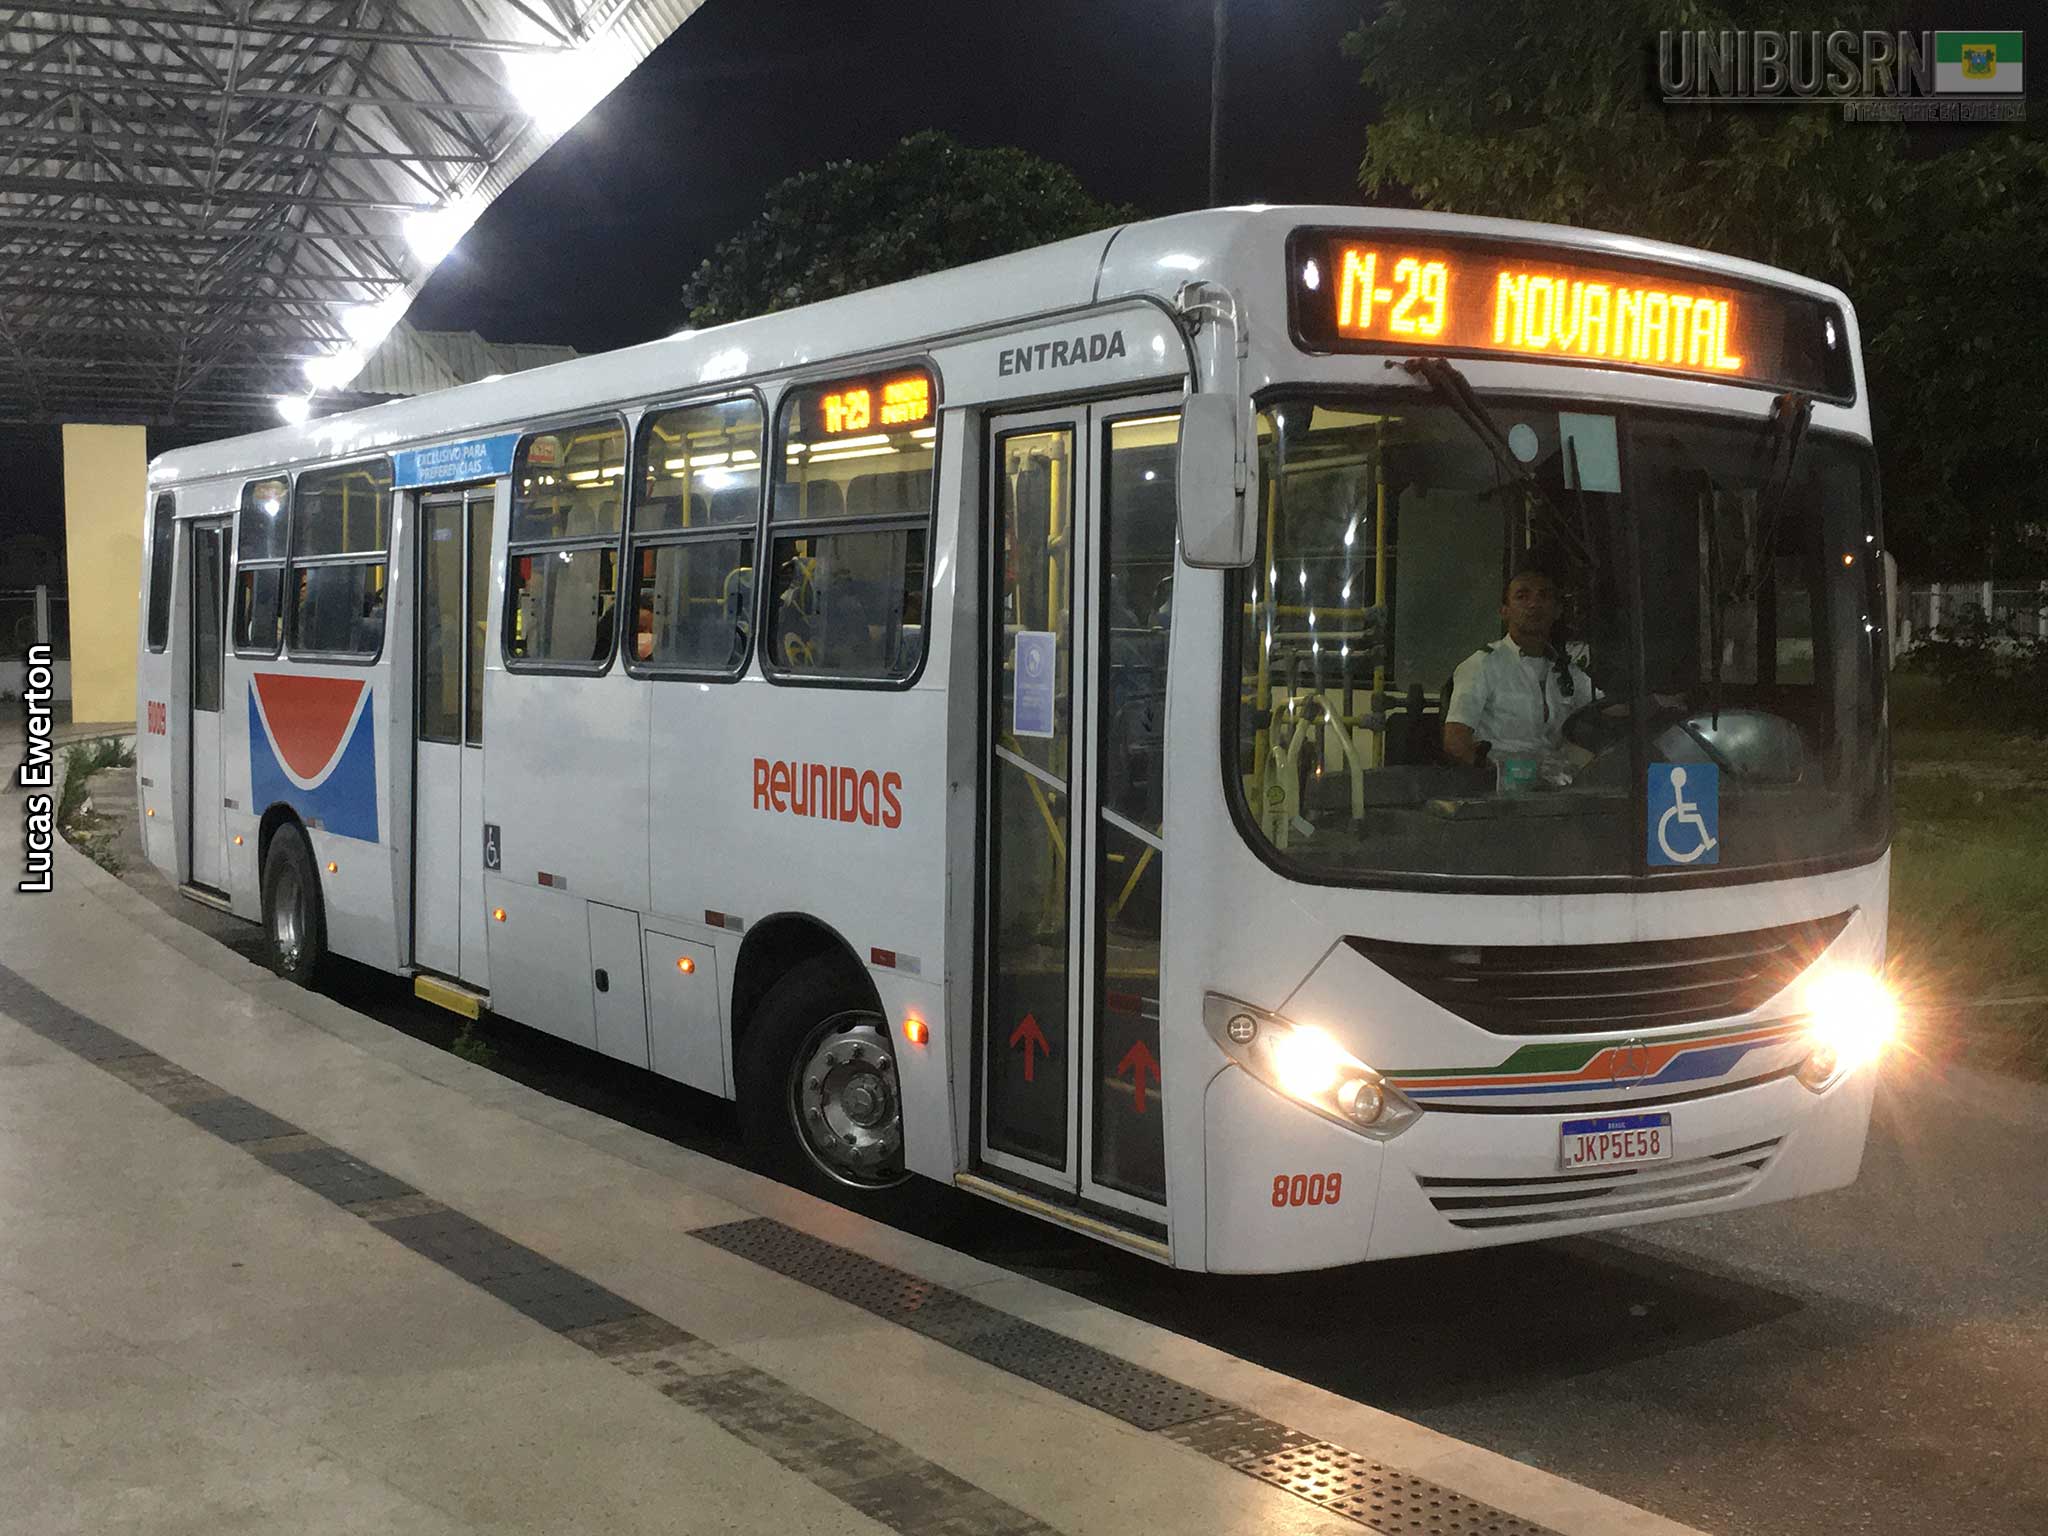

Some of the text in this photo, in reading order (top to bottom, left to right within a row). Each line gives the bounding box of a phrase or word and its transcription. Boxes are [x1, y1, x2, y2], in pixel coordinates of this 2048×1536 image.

[1339, 249, 1449, 335] N-29
[999, 330, 1126, 377] ENTRADA
[416, 443, 487, 467] EXCLUSIVO PARA
[1574, 1130, 1660, 1163] JKP5E58
[1271, 1172, 1342, 1208] 8009
